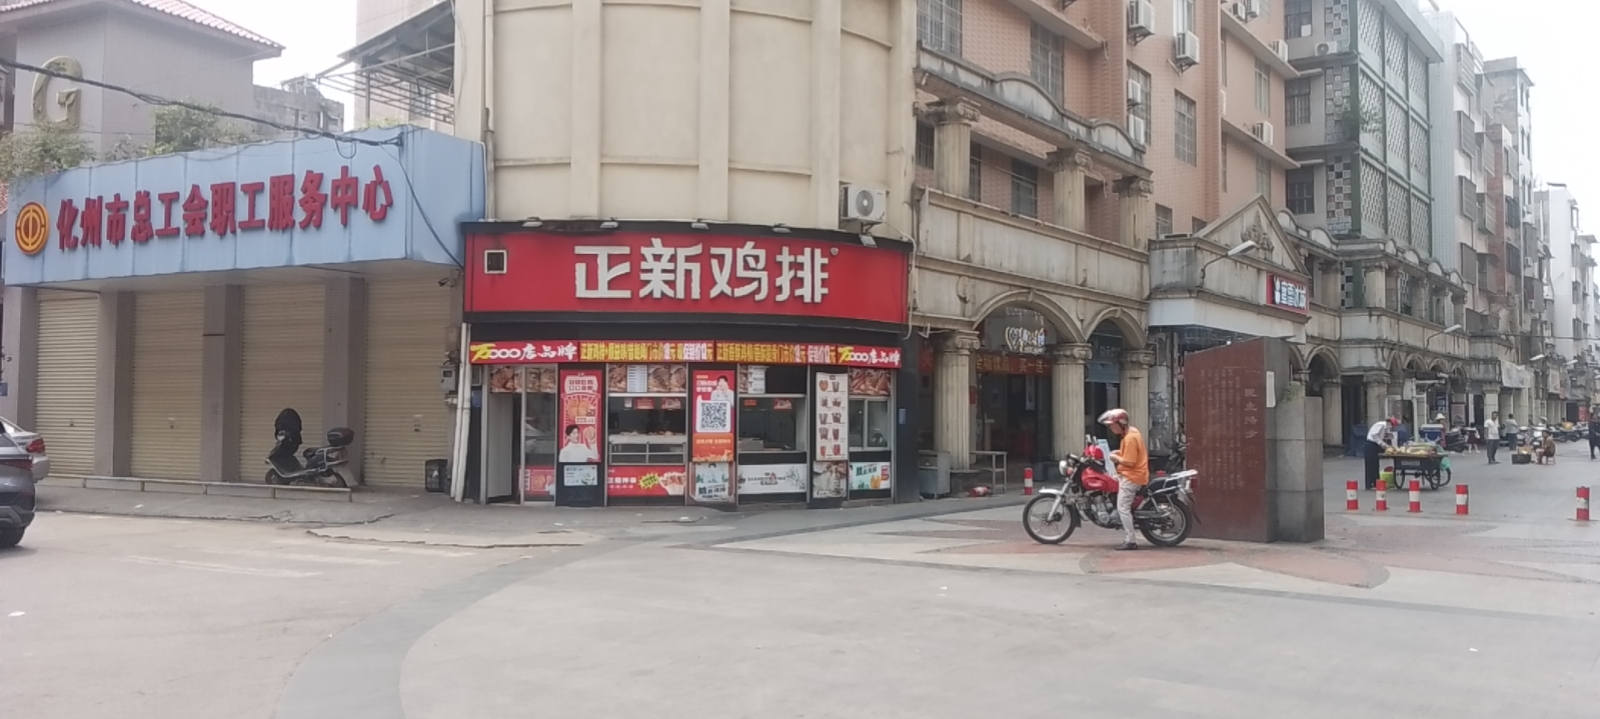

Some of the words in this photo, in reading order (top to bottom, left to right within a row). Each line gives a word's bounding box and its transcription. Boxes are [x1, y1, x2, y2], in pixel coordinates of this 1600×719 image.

[31, 56, 83, 130] G
[57, 164, 394, 251] 化州市总工会职工服务中心
[574, 238, 829, 303] 正新鸡排
